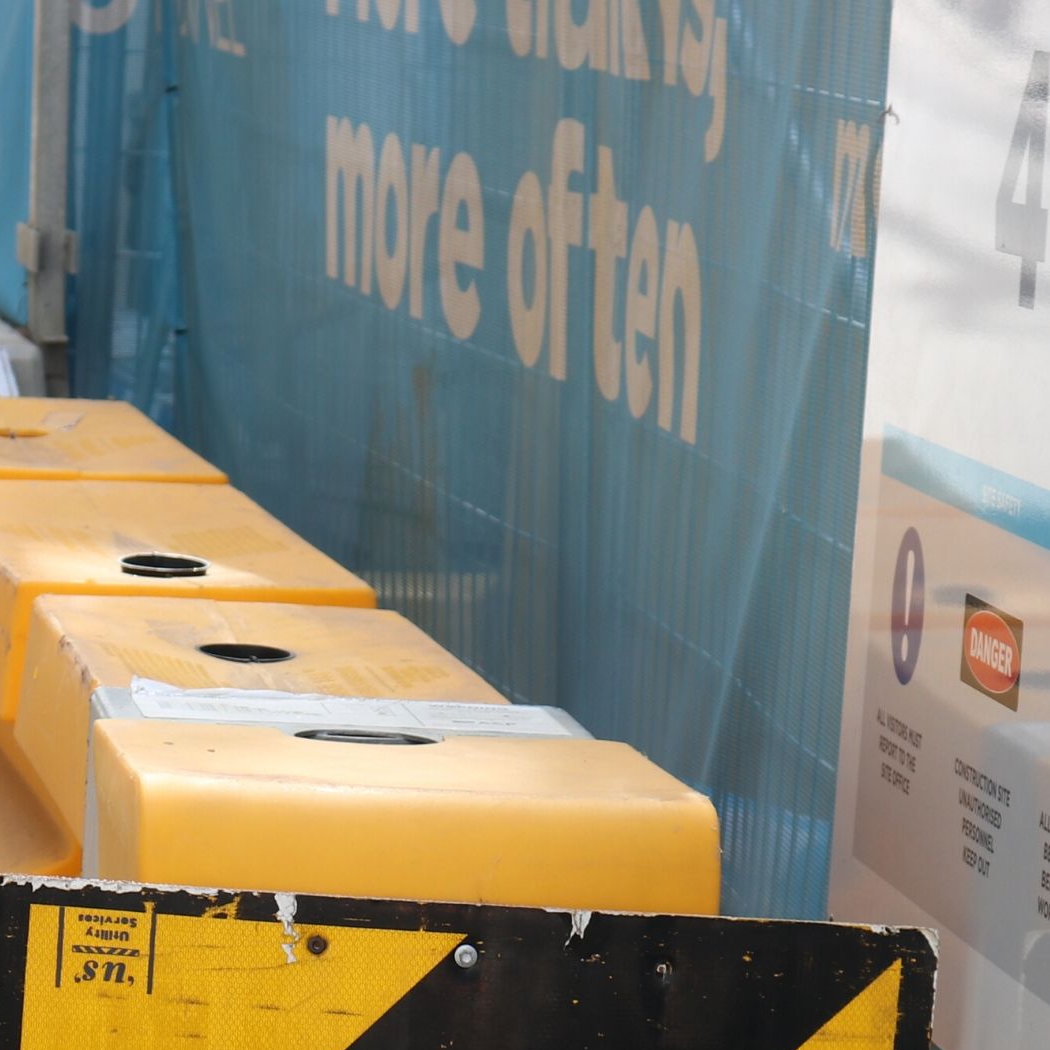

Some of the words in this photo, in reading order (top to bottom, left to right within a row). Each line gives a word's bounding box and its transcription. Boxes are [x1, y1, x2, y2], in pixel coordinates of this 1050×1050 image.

[326, 115, 485, 340] more
[507, 117, 702, 445] often
[970, 627, 1013, 678] DANGER
[954, 757, 997, 798] CONSTRUCTION
[997, 785, 1011, 808] SITE
[958, 787, 1002, 830] UNAUTHORISED
[961, 817, 995, 854] PERSONNEL
[962, 845, 977, 868] KEEP
[978, 856, 990, 878] OUT
[78, 913, 138, 928] Services
[86, 926, 130, 942] Utility
